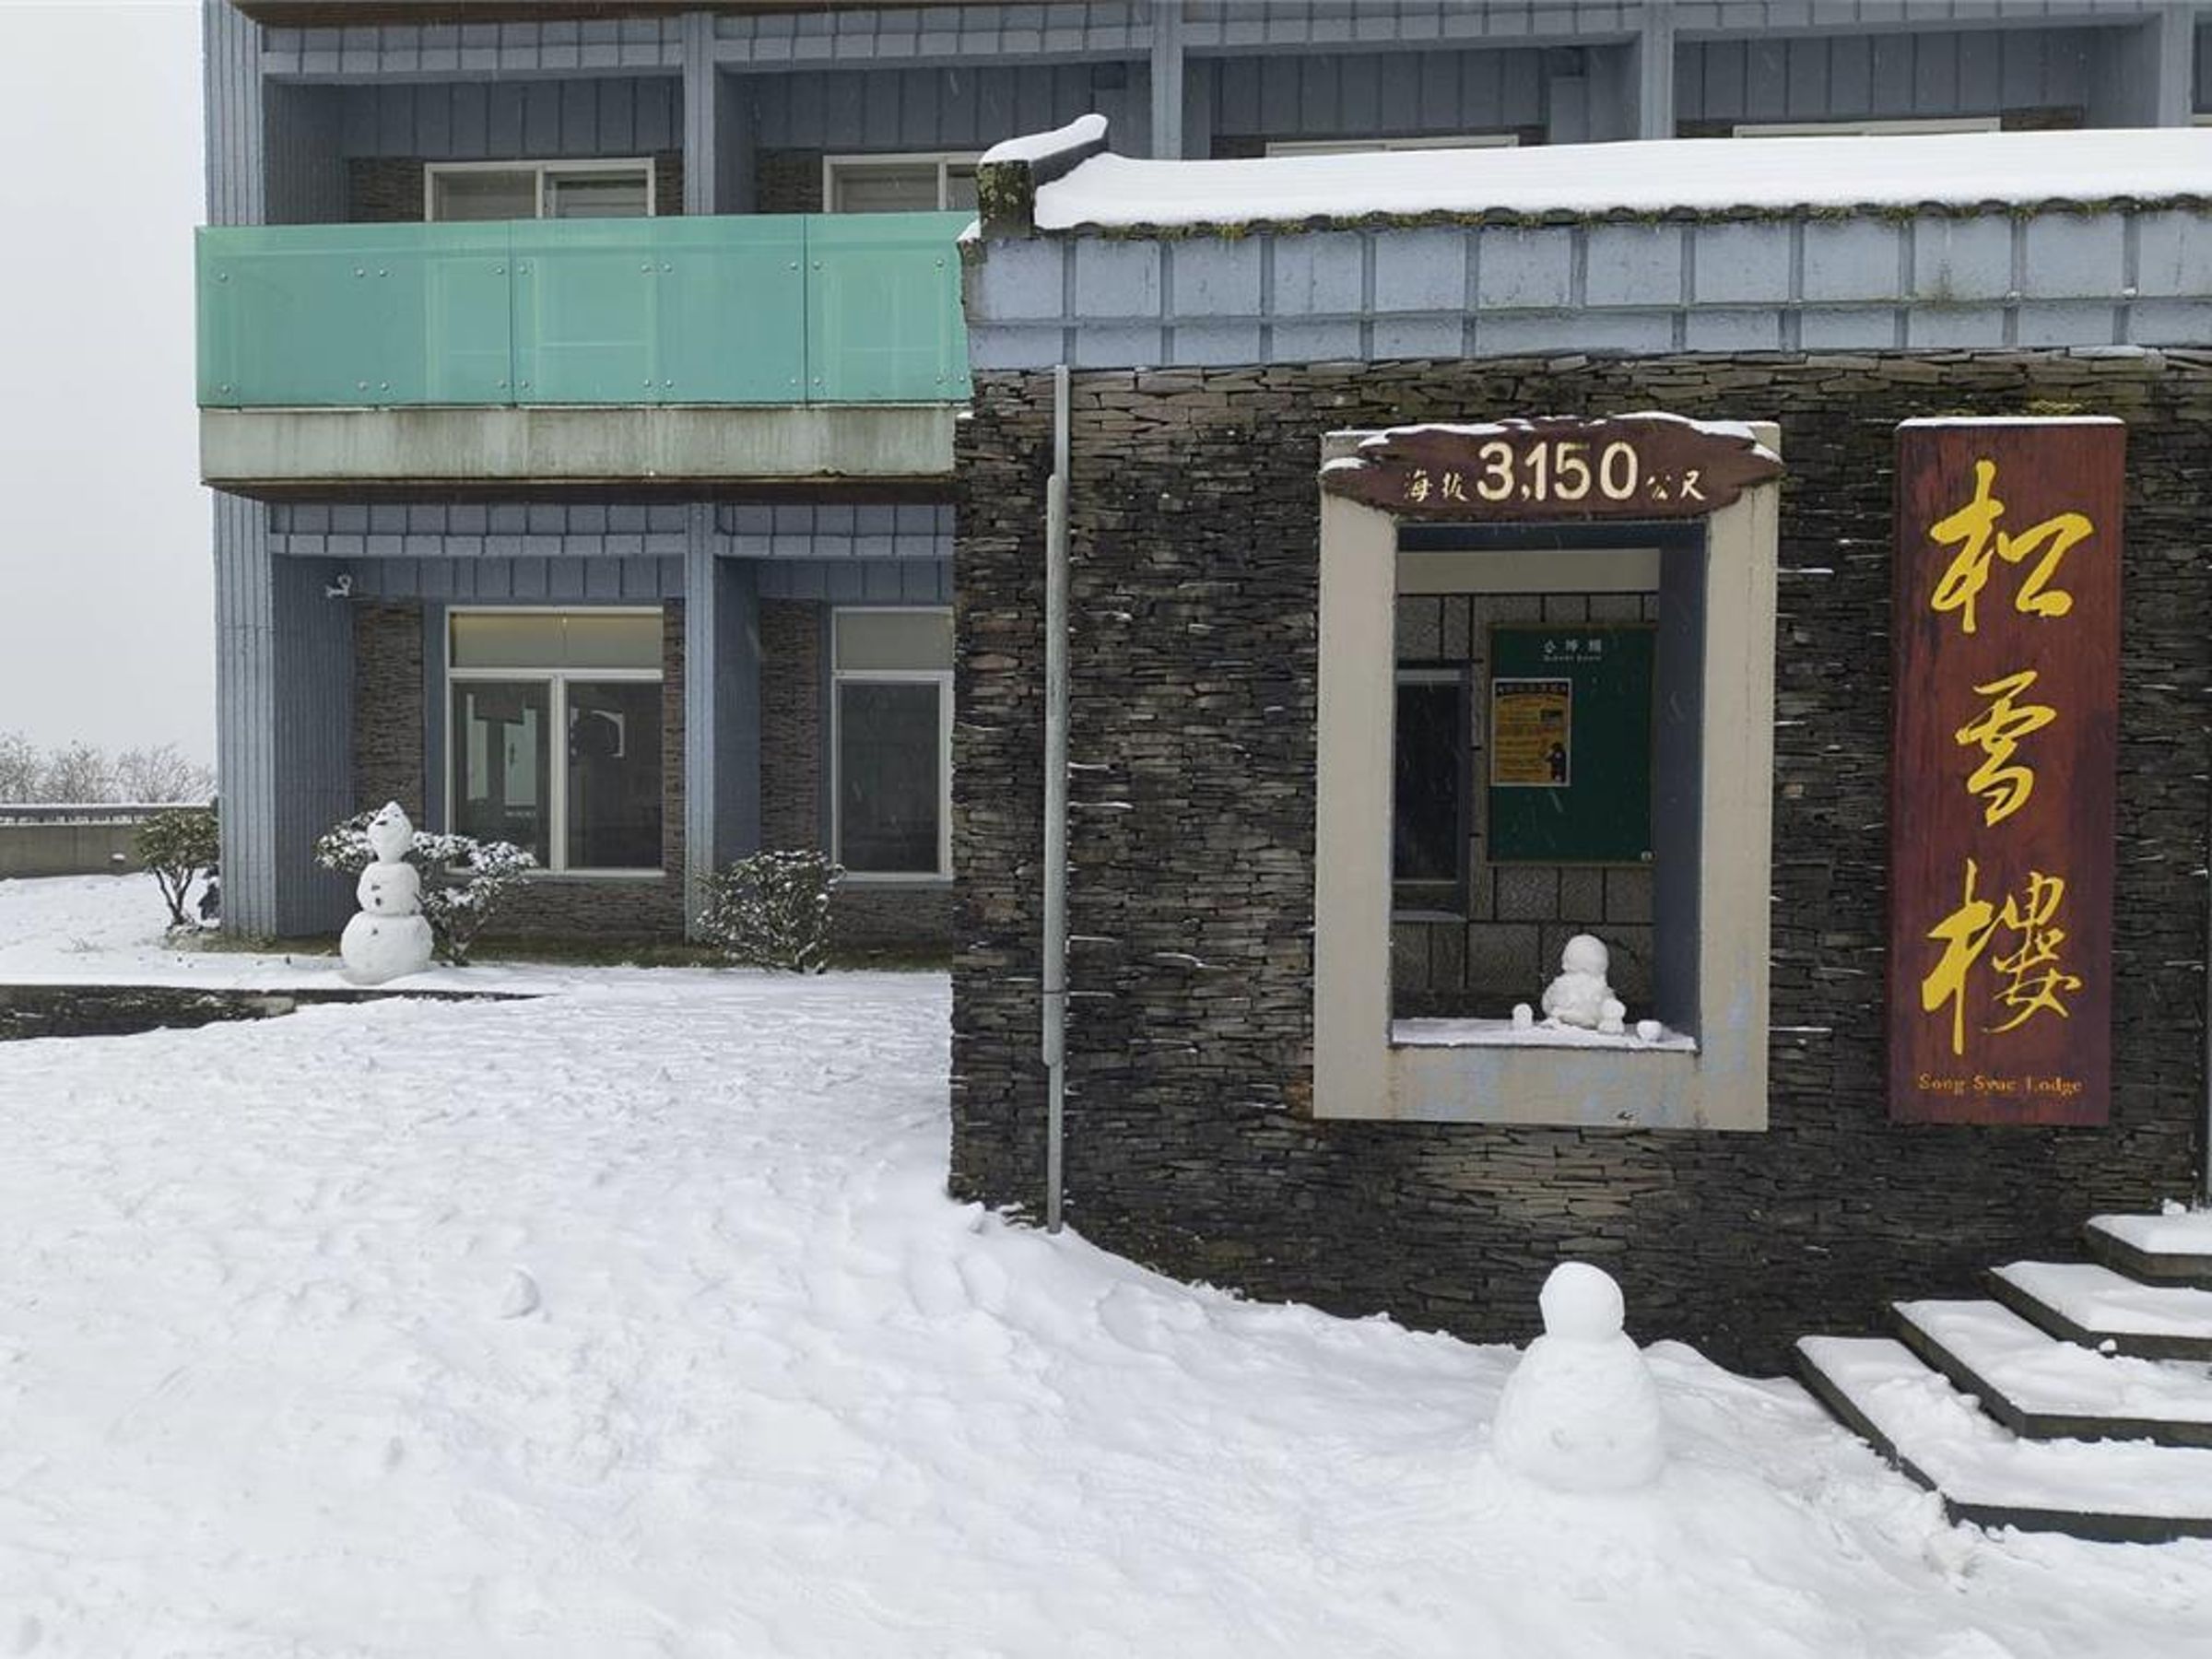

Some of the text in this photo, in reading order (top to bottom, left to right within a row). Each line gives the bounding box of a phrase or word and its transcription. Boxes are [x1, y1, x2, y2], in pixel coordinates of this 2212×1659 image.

[1477, 441, 1639, 501] 3,150
[1918, 1072, 1965, 1096] Song
[2026, 1076, 2083, 1097] Lodge
